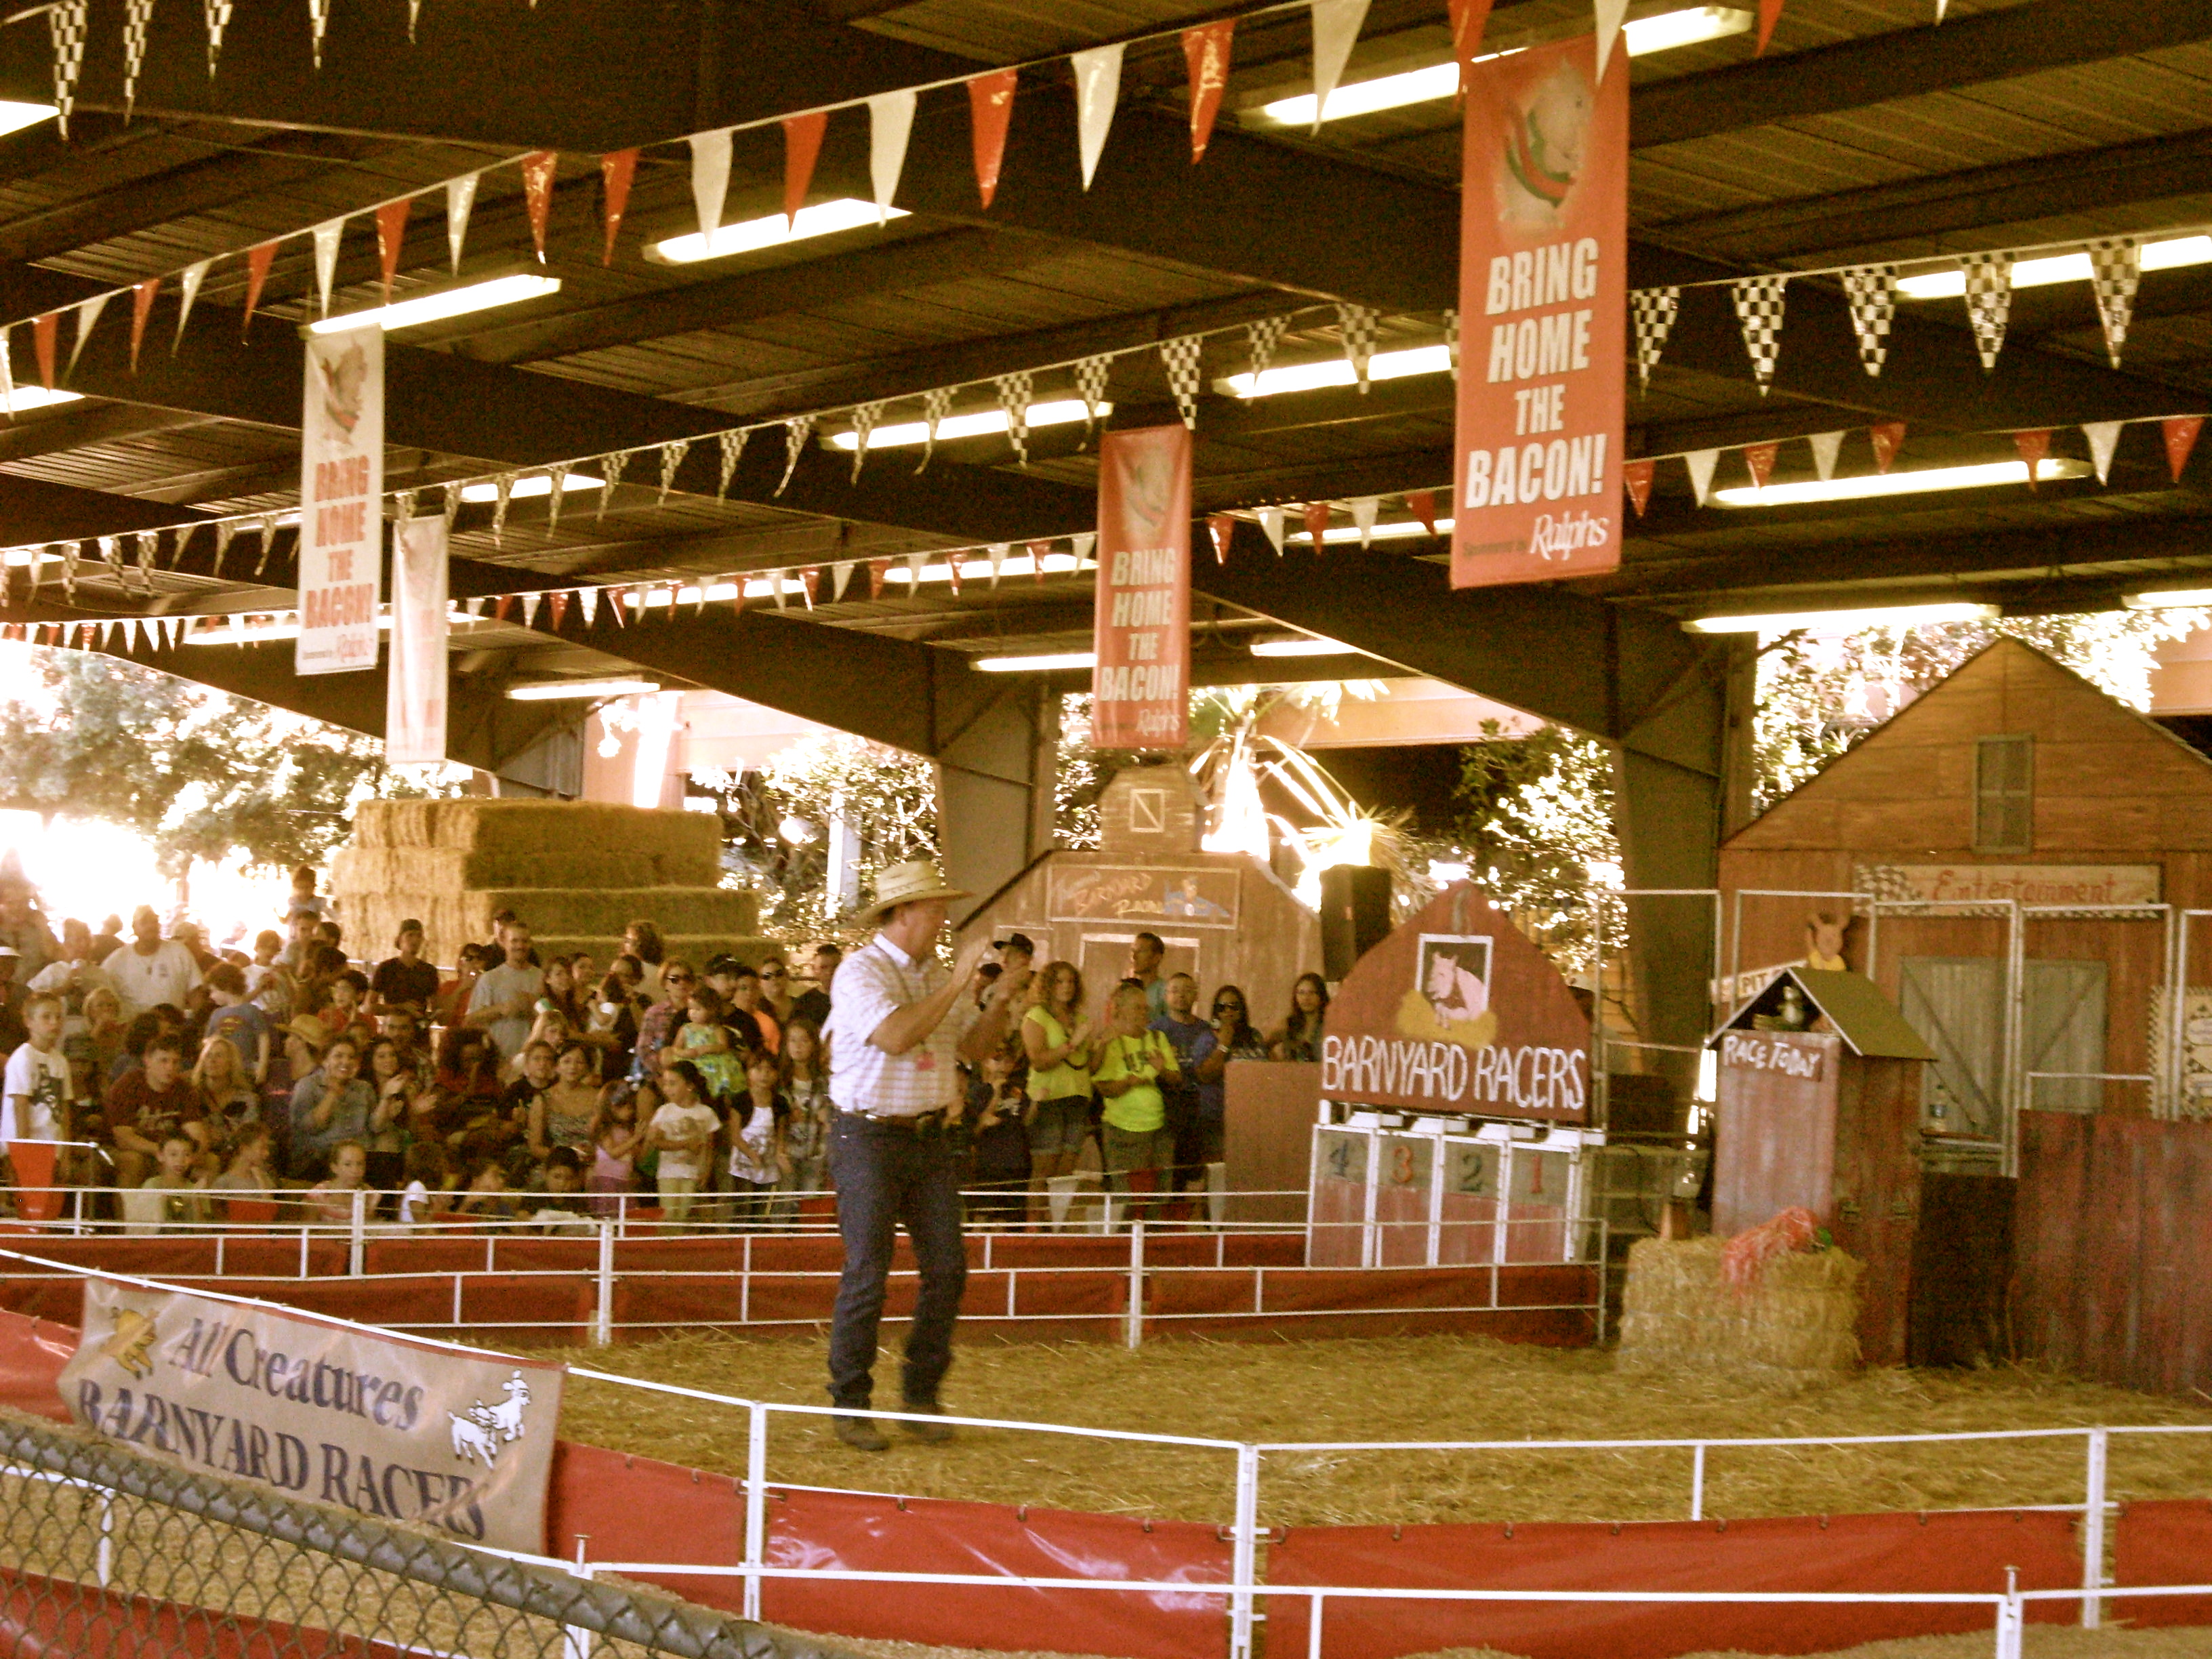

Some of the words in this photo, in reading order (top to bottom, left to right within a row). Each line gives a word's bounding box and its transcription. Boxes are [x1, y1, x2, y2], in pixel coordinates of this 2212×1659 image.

[1485, 237, 1599, 314] BRING
[1487, 309, 1593, 383] HOME
[1515, 384, 1565, 435] THE
[1465, 433, 1607, 509] BACON!
[1529, 510, 1610, 561] Ralphs
[1110, 548, 1176, 586] BRING
[1112, 590, 1172, 627] HOME
[1128, 632, 1160, 660] THE
[1101, 664, 1181, 701] BACON!
[1723, 1035, 1767, 1069] RACE
[1322, 1035, 1468, 1102] BARNYARD
[1474, 1044, 1586, 1110] RACERS
[1329, 1140, 1349, 1177] 4
[1391, 1145, 1414, 1183] 3
[1460, 1154, 1483, 1191] 2
[1530, 1155, 1542, 1193] 1
[224, 1328, 424, 1431] Creatures
[79, 1378, 308, 1492] BARNYARD
